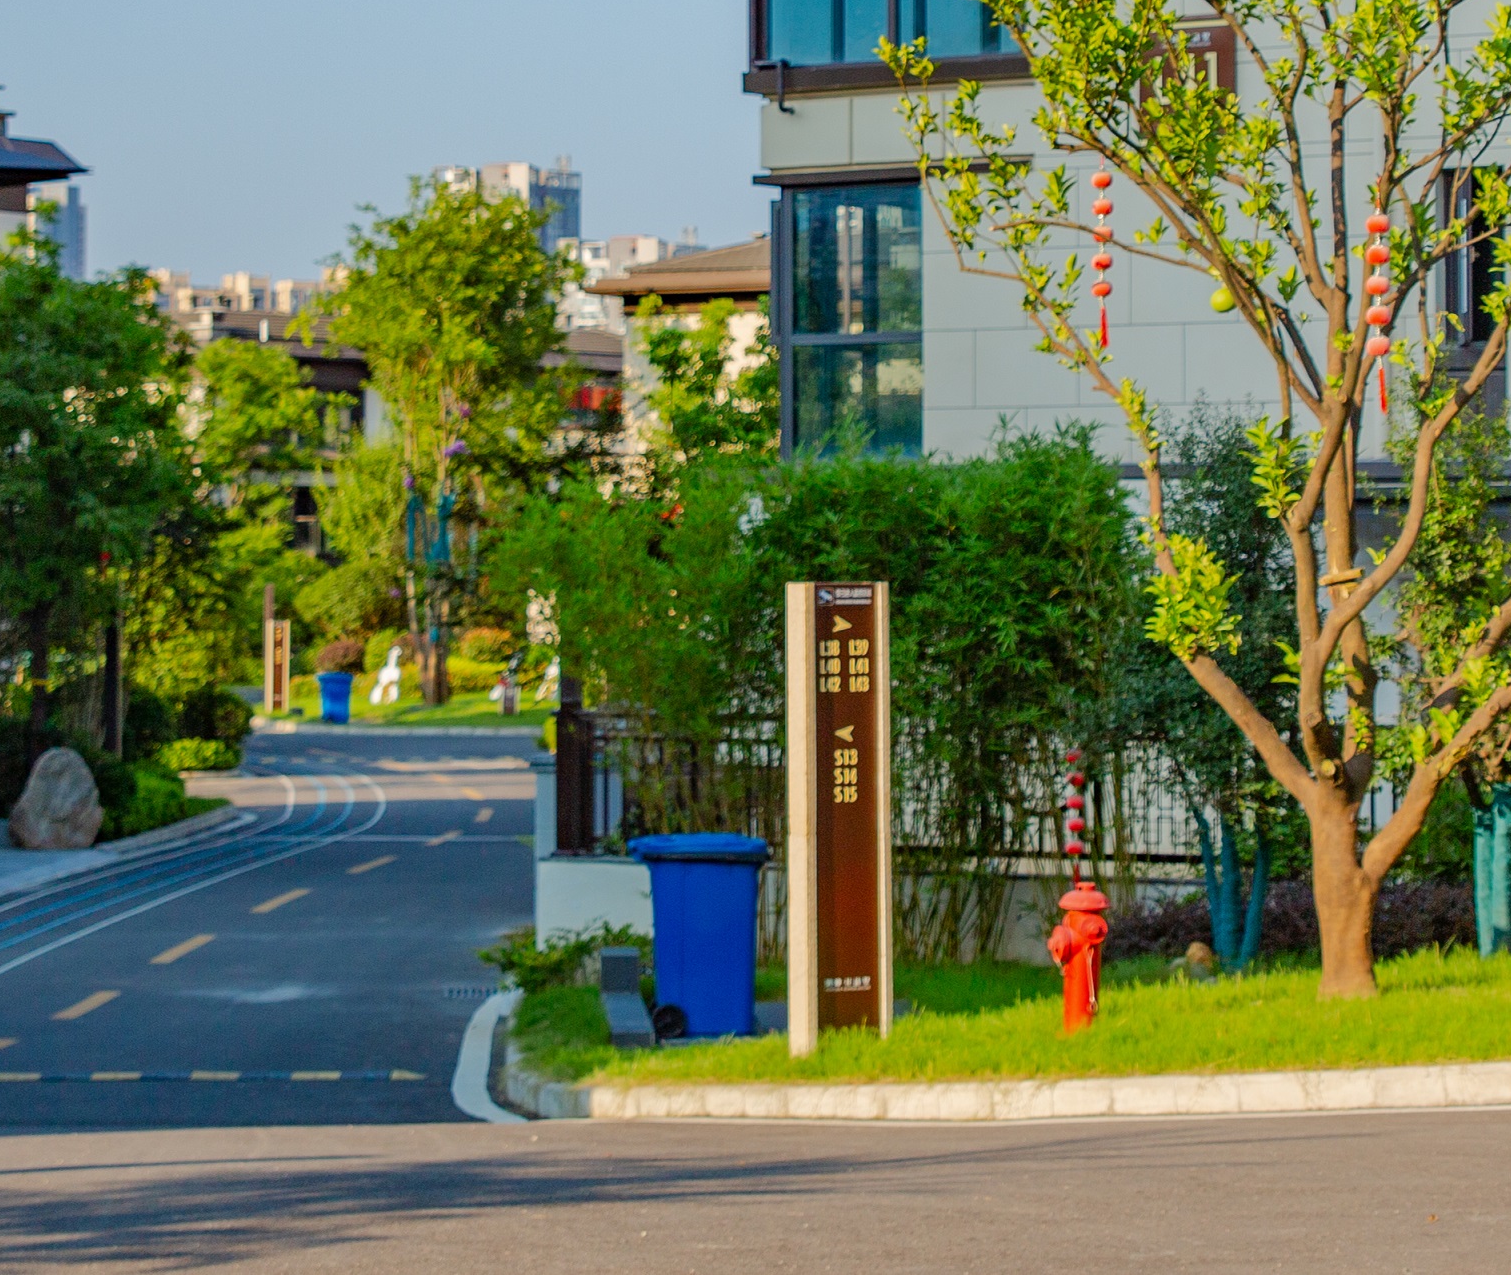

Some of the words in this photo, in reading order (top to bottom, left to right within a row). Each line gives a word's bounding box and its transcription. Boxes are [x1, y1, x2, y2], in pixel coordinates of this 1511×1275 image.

[819, 639, 840, 656] L38
[848, 638, 869, 656] L39
[819, 657, 841, 675] L40
[849, 657, 869, 675] L41
[819, 675, 841, 693] L42
[849, 675, 869, 693] L43
[833, 748, 858, 766] S13
[833, 767, 858, 784] S14
[833, 785, 858, 803] S15
